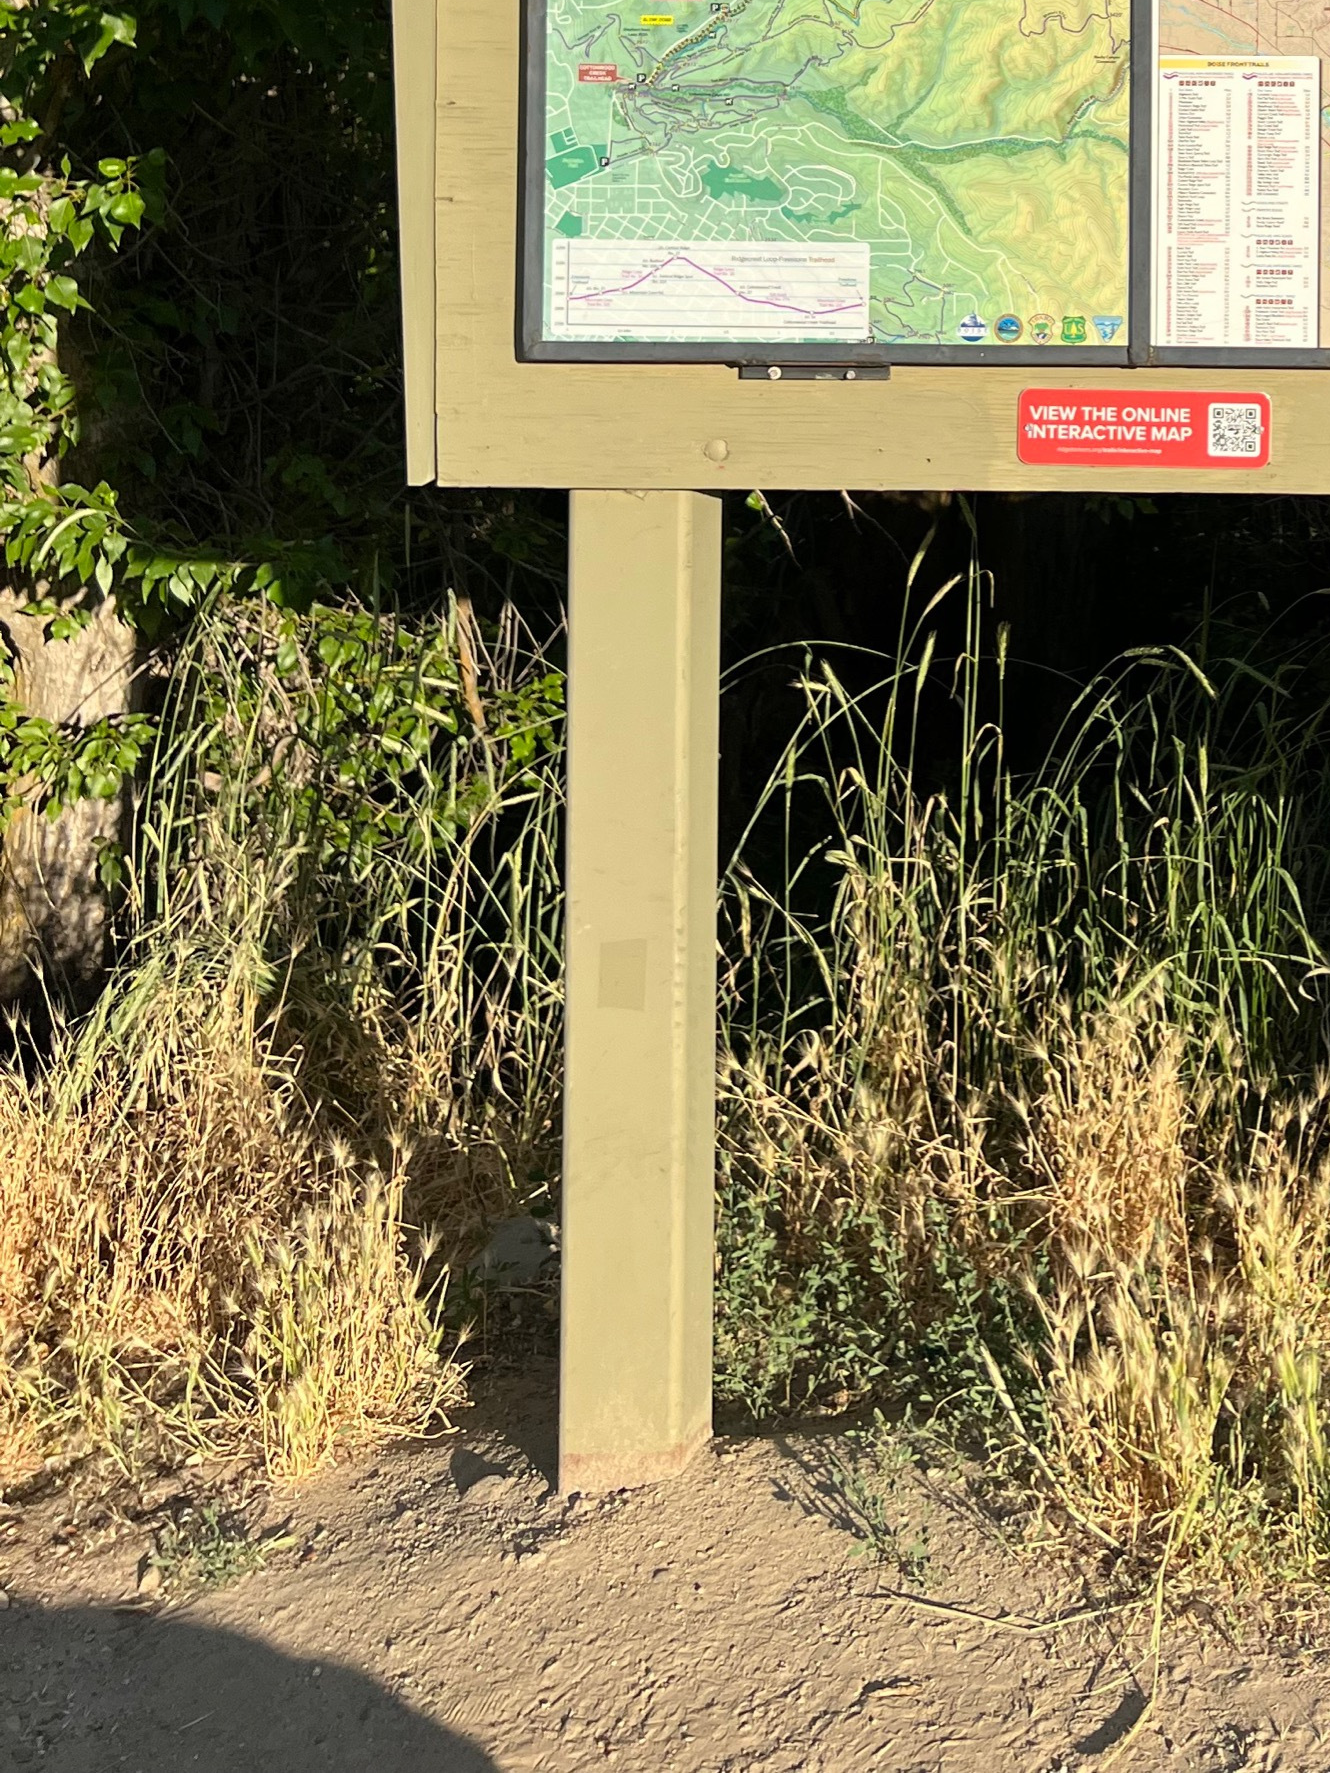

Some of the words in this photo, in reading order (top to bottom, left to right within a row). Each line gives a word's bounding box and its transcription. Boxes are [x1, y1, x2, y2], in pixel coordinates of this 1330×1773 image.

[1029, 405, 1080, 421] VIEW
[1081, 406, 1118, 421] THE
[1121, 407, 1191, 423] ONLINE
[1027, 424, 1149, 441] INTERACTIVE
[1151, 426, 1193, 442] MAP
